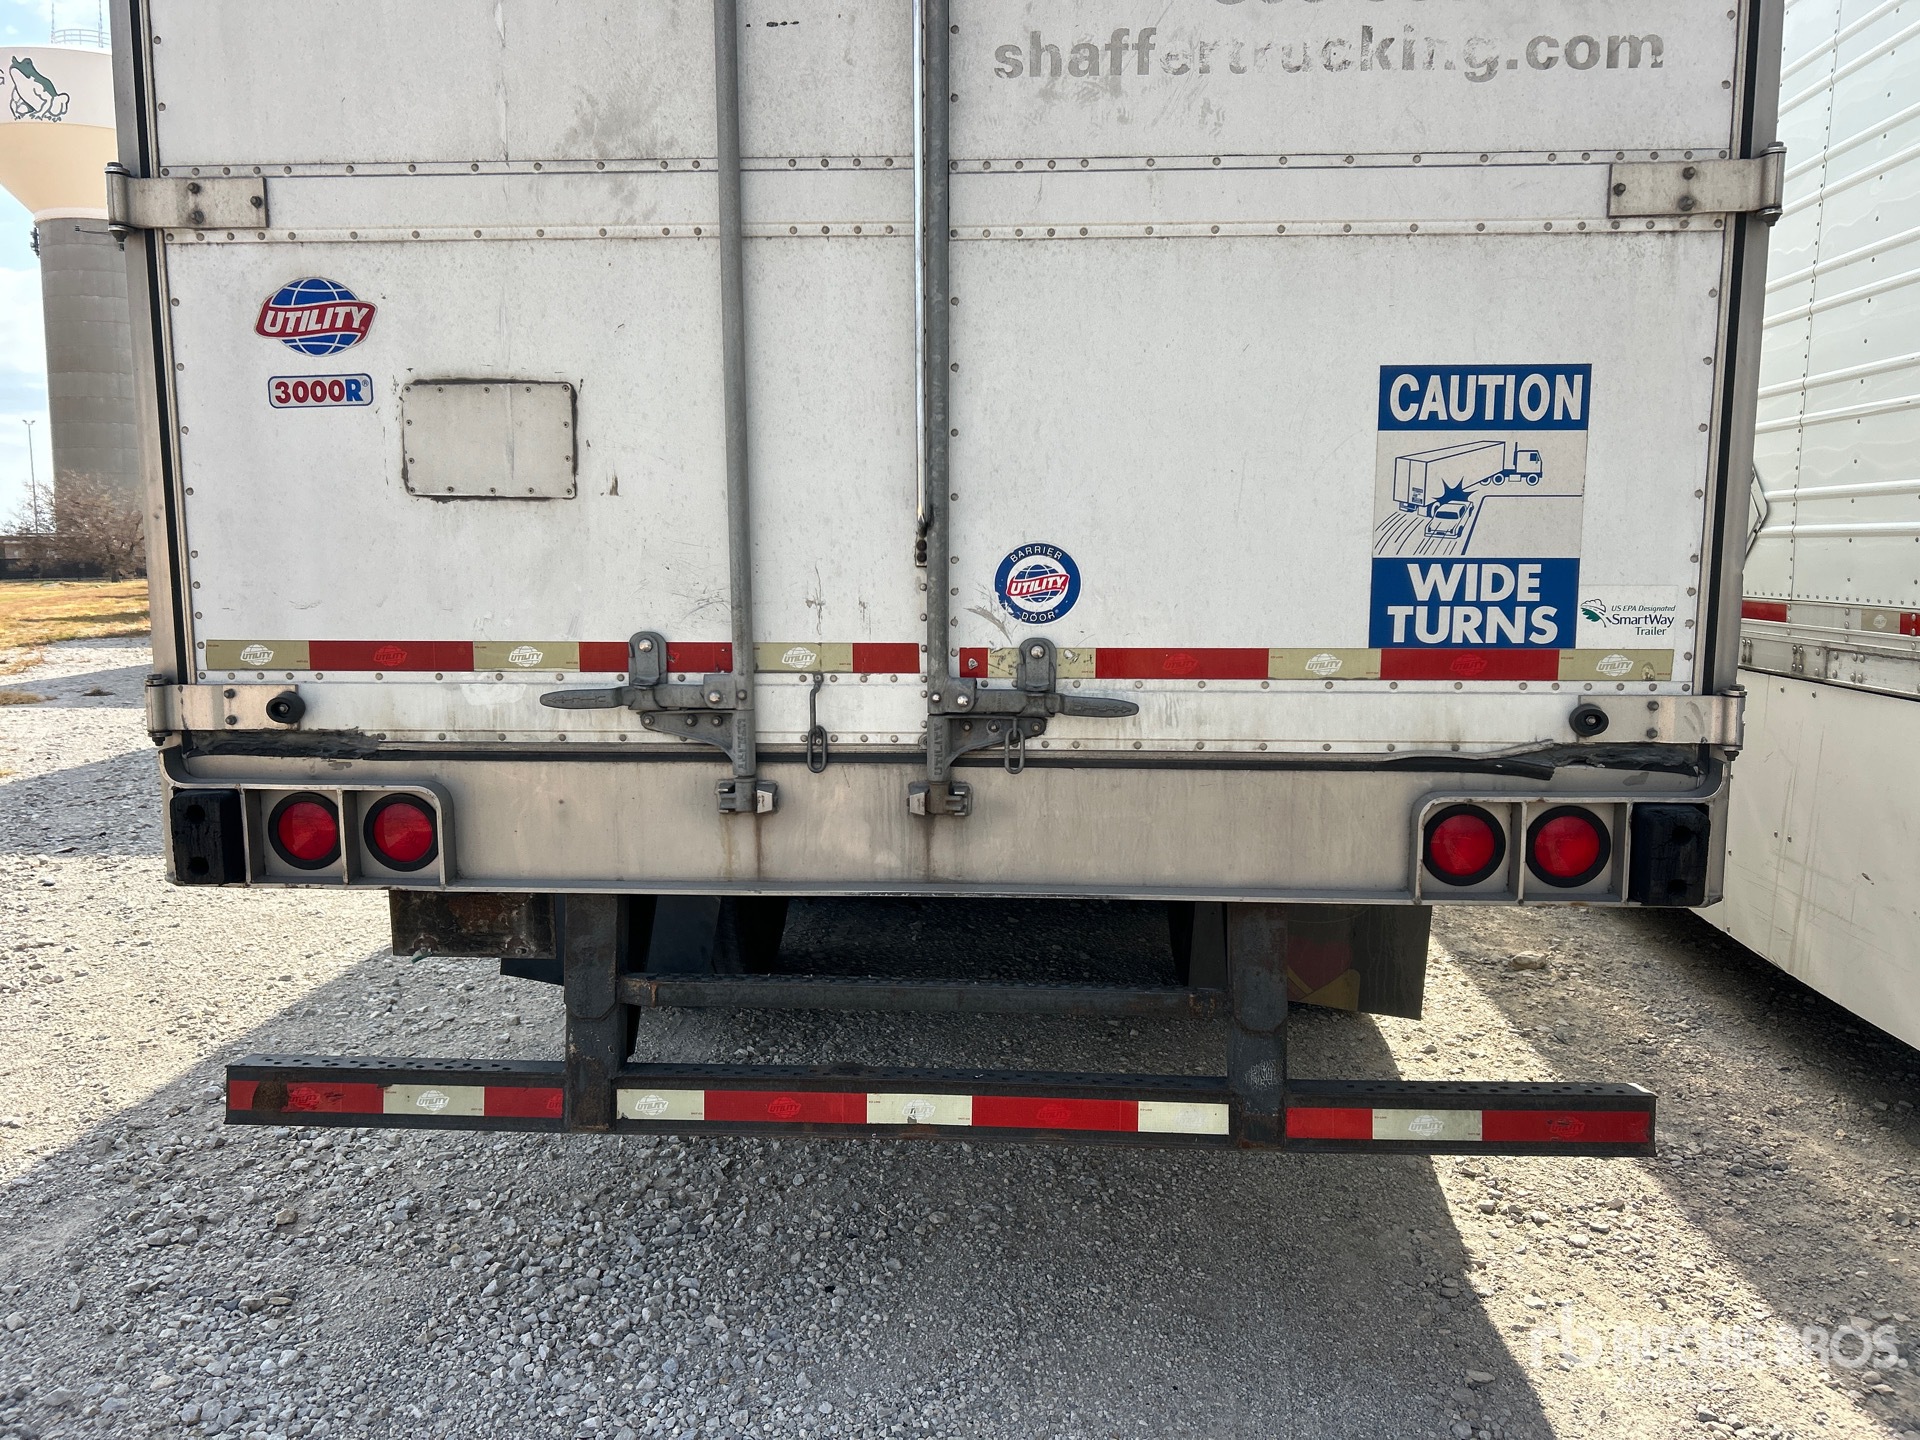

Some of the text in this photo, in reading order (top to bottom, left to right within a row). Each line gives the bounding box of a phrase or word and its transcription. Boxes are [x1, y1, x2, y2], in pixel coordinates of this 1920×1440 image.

[263, 306, 369, 333] UTILITY
[1390, 373, 1584, 422] CAUTION
[1010, 545, 1063, 563] BARRIER
[1010, 576, 1066, 595] UTILITY
[1406, 563, 1542, 602] WIDE
[1611, 604, 1676, 614] US EPA Designated
[1021, 611, 1056, 622] DOOR
[1610, 613, 1675, 628] SmartWay
[1387, 605, 1558, 645] TURNS
[1635, 626, 1667, 636] Trailer
[242, 651, 273, 661] UTILITY
[511, 652, 542, 662] UTILITY
[784, 654, 815, 663] UTILITY
[1307, 659, 1341, 669] UTILITY
[1599, 660, 1632, 670] UTILITY
[418, 1097, 448, 1106] UTILITY
[637, 1101, 668, 1111] UTILITY
[769, 1103, 800, 1113] UTILITY
[1411, 1122, 1443, 1132] UTILITY
